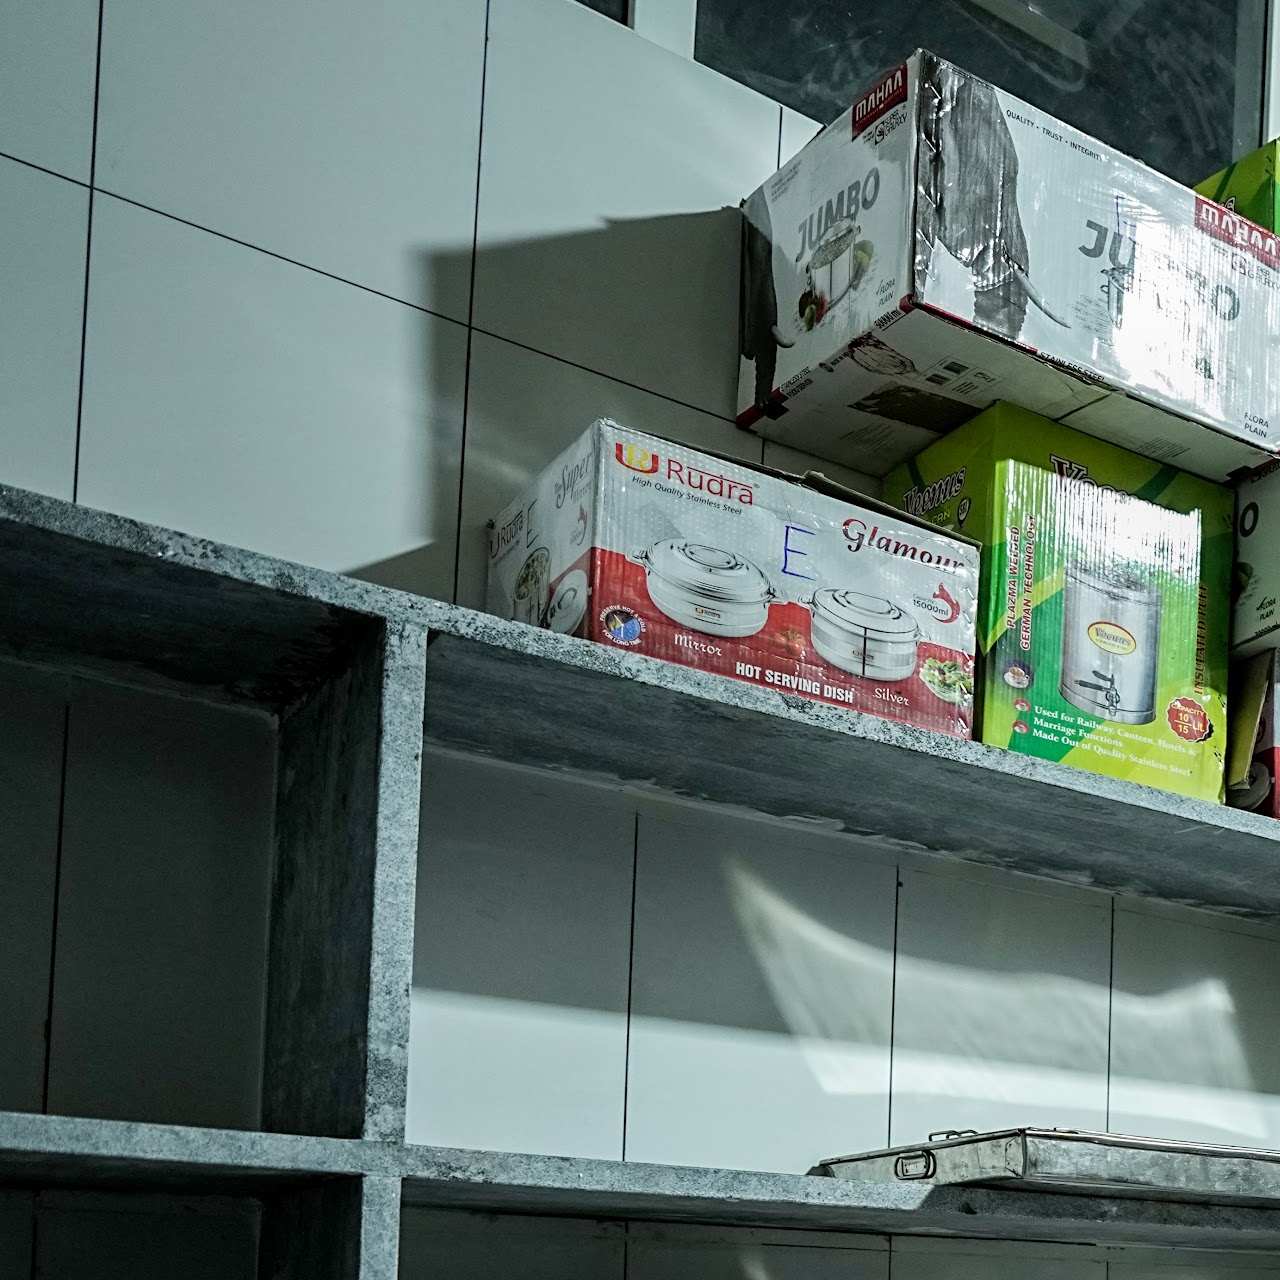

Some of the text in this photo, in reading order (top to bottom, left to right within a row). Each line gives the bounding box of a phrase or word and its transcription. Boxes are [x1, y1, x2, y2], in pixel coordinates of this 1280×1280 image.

[1006, 109, 1035, 128] QUALITY
[1042, 127, 1063, 143] TRUST
[796, 166, 880, 262] JUMBO
[1244, 412, 1269, 428] FLORA
[1244, 423, 1268, 438] PLAIN
[556, 452, 592, 509] Super
[632, 476, 742, 516] High Quality Stainless Steel
[667, 459, 753, 506] Rudra
[781, 525, 816, 581] E
[842, 518, 965, 574] Glamour
[912, 599, 949, 617] 15000ml
[1006, 578, 1018, 628] PLAZMA
[1260, 608, 1274, 621] PLAIN
[674, 633, 723, 656] Mirror
[1021, 597, 1033, 651] GERMAN
[1194, 620, 1206, 695] INSULATED
[735, 661, 854, 703] HOT SERVING DISH
[875, 687, 910, 707] Silver
[1033, 717, 1123, 748] Marriage Functions
[1034, 705, 1058, 719] Used
[1061, 713, 1074, 723] for
[1158, 739, 1186, 753] Hotels
[1178, 712, 1189, 722] 10
[1178, 724, 1189, 734] 15
[1032, 728, 1191, 777] Made Out of Quality Stainless Steel
